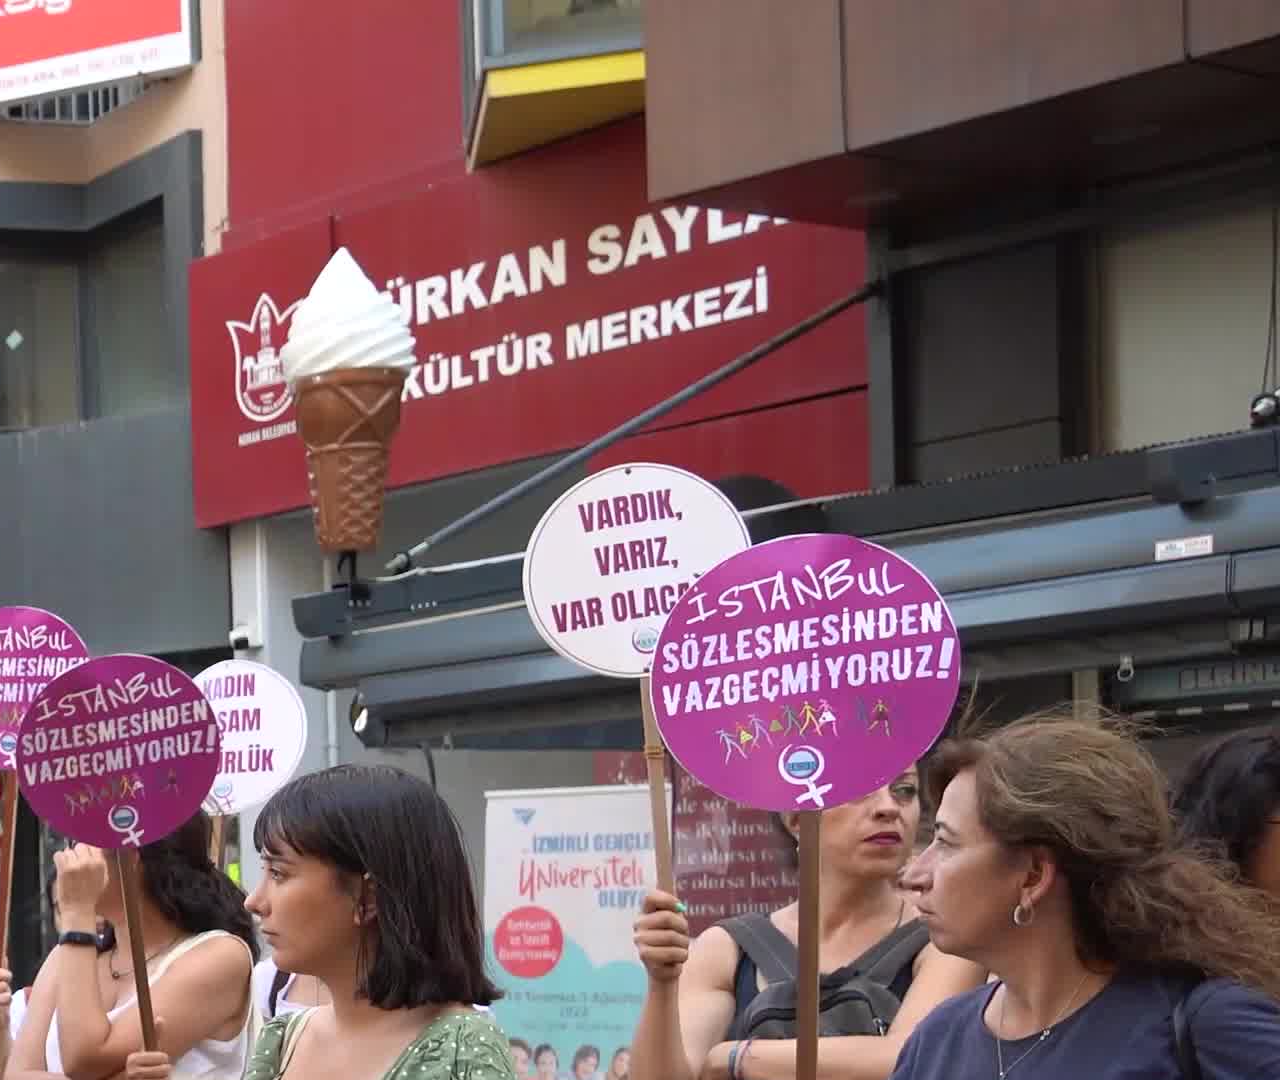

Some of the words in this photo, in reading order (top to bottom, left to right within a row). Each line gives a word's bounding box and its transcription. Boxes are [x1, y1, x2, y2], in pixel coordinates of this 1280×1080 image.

[382, 239, 567, 326] ÜRKAN
[401, 332, 553, 402] KÜLTÜR
[566, 266, 769, 360] MERKEZİ
[578, 488, 683, 533] VARDIK,
[594, 537, 679, 577] VARIZ,
[551, 597, 604, 634] VAR
[611, 580, 690, 622] OLAC
[685, 557, 905, 626] İSTANBUL
[662, 600, 943, 674] SÖZLEŞMESİNDEN
[36, 671, 182, 724] İSTANBUL
[203, 672, 256, 701] KADIN
[662, 637, 955, 717] VAZGEÇMİYORUZ!
[217, 707, 261, 741] ŞAM
[23, 724, 217, 788] VAZGEÇMİYORUZ!
[216, 744, 274, 775] RLÜK
[685, 897, 726, 917] lursa
